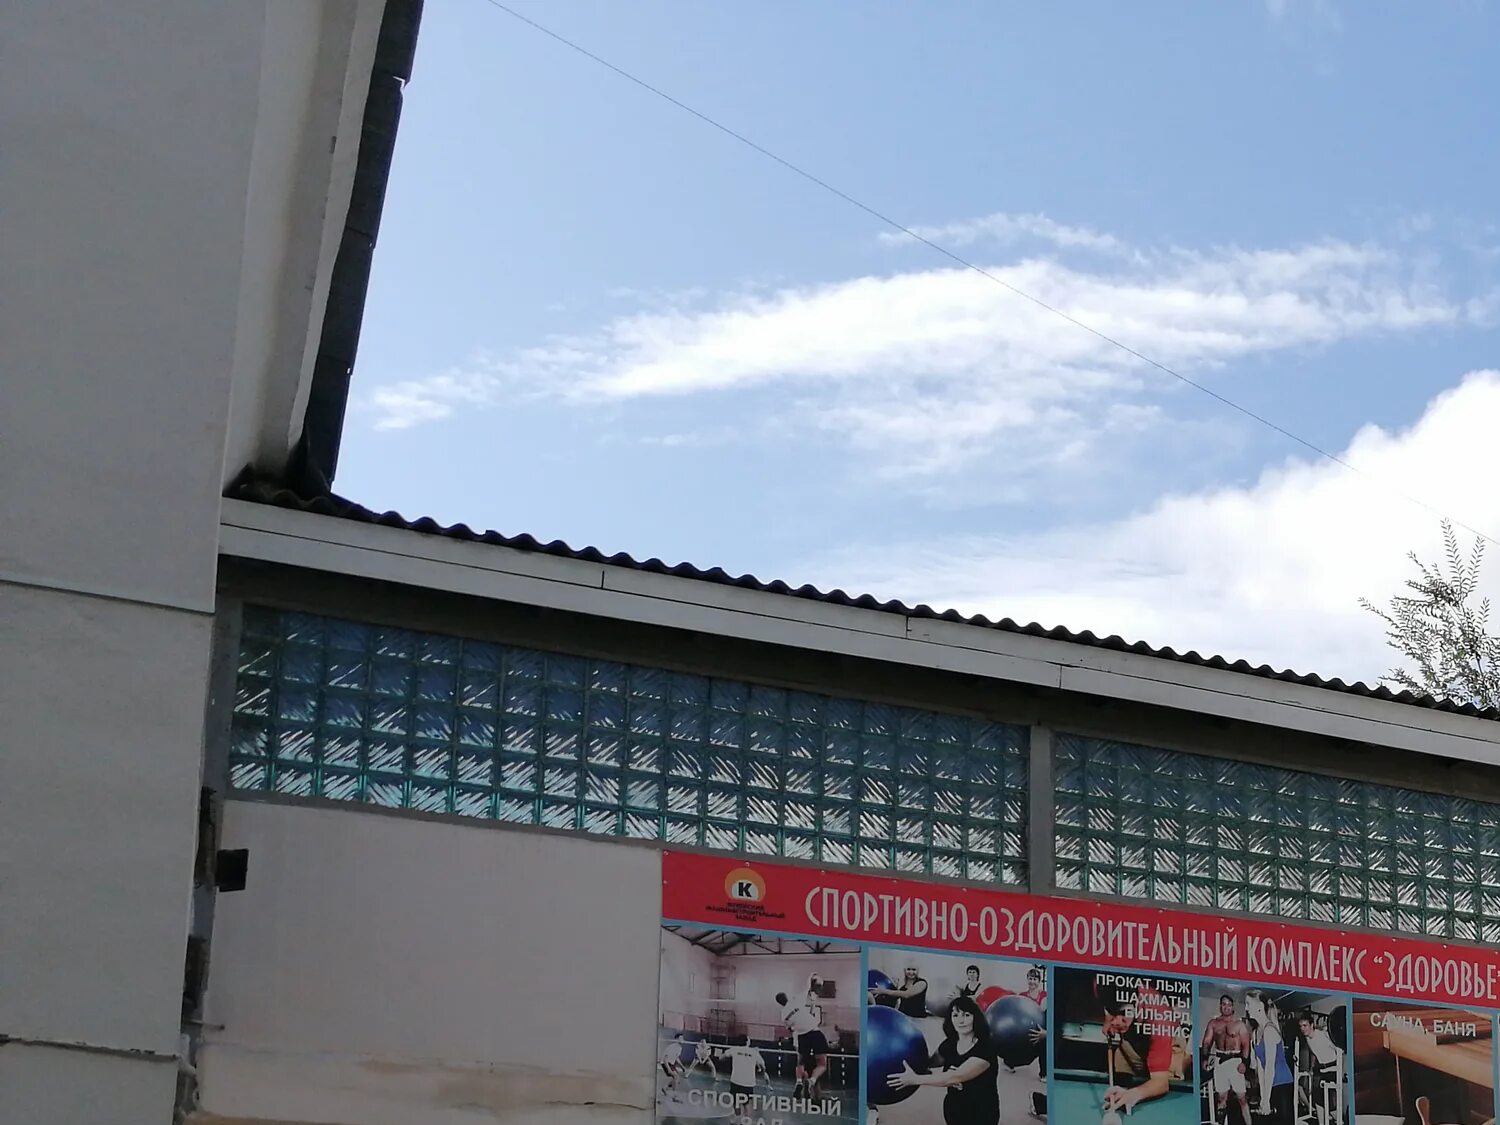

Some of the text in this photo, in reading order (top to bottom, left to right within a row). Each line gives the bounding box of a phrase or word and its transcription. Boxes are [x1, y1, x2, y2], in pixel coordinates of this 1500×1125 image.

[805, 886, 1237, 971] СПОРТИВНО-ОЗДОРОВИТЕЛЬНЫЙ
[1247, 936, 1367, 986] КОМПЛЕКС
[1096, 973, 1191, 994] ПРОКАТ ЛЫЖ
[1115, 990, 1190, 1009] ШАХМАТЫ
[1124, 1007, 1191, 1026] БИЛЬЯРД
[1133, 1022, 1190, 1038] ТЕННИС
[1433, 1019, 1476, 1037] БАНЯ
[687, 1088, 842, 1116] СПОРТИВНЫЙ
